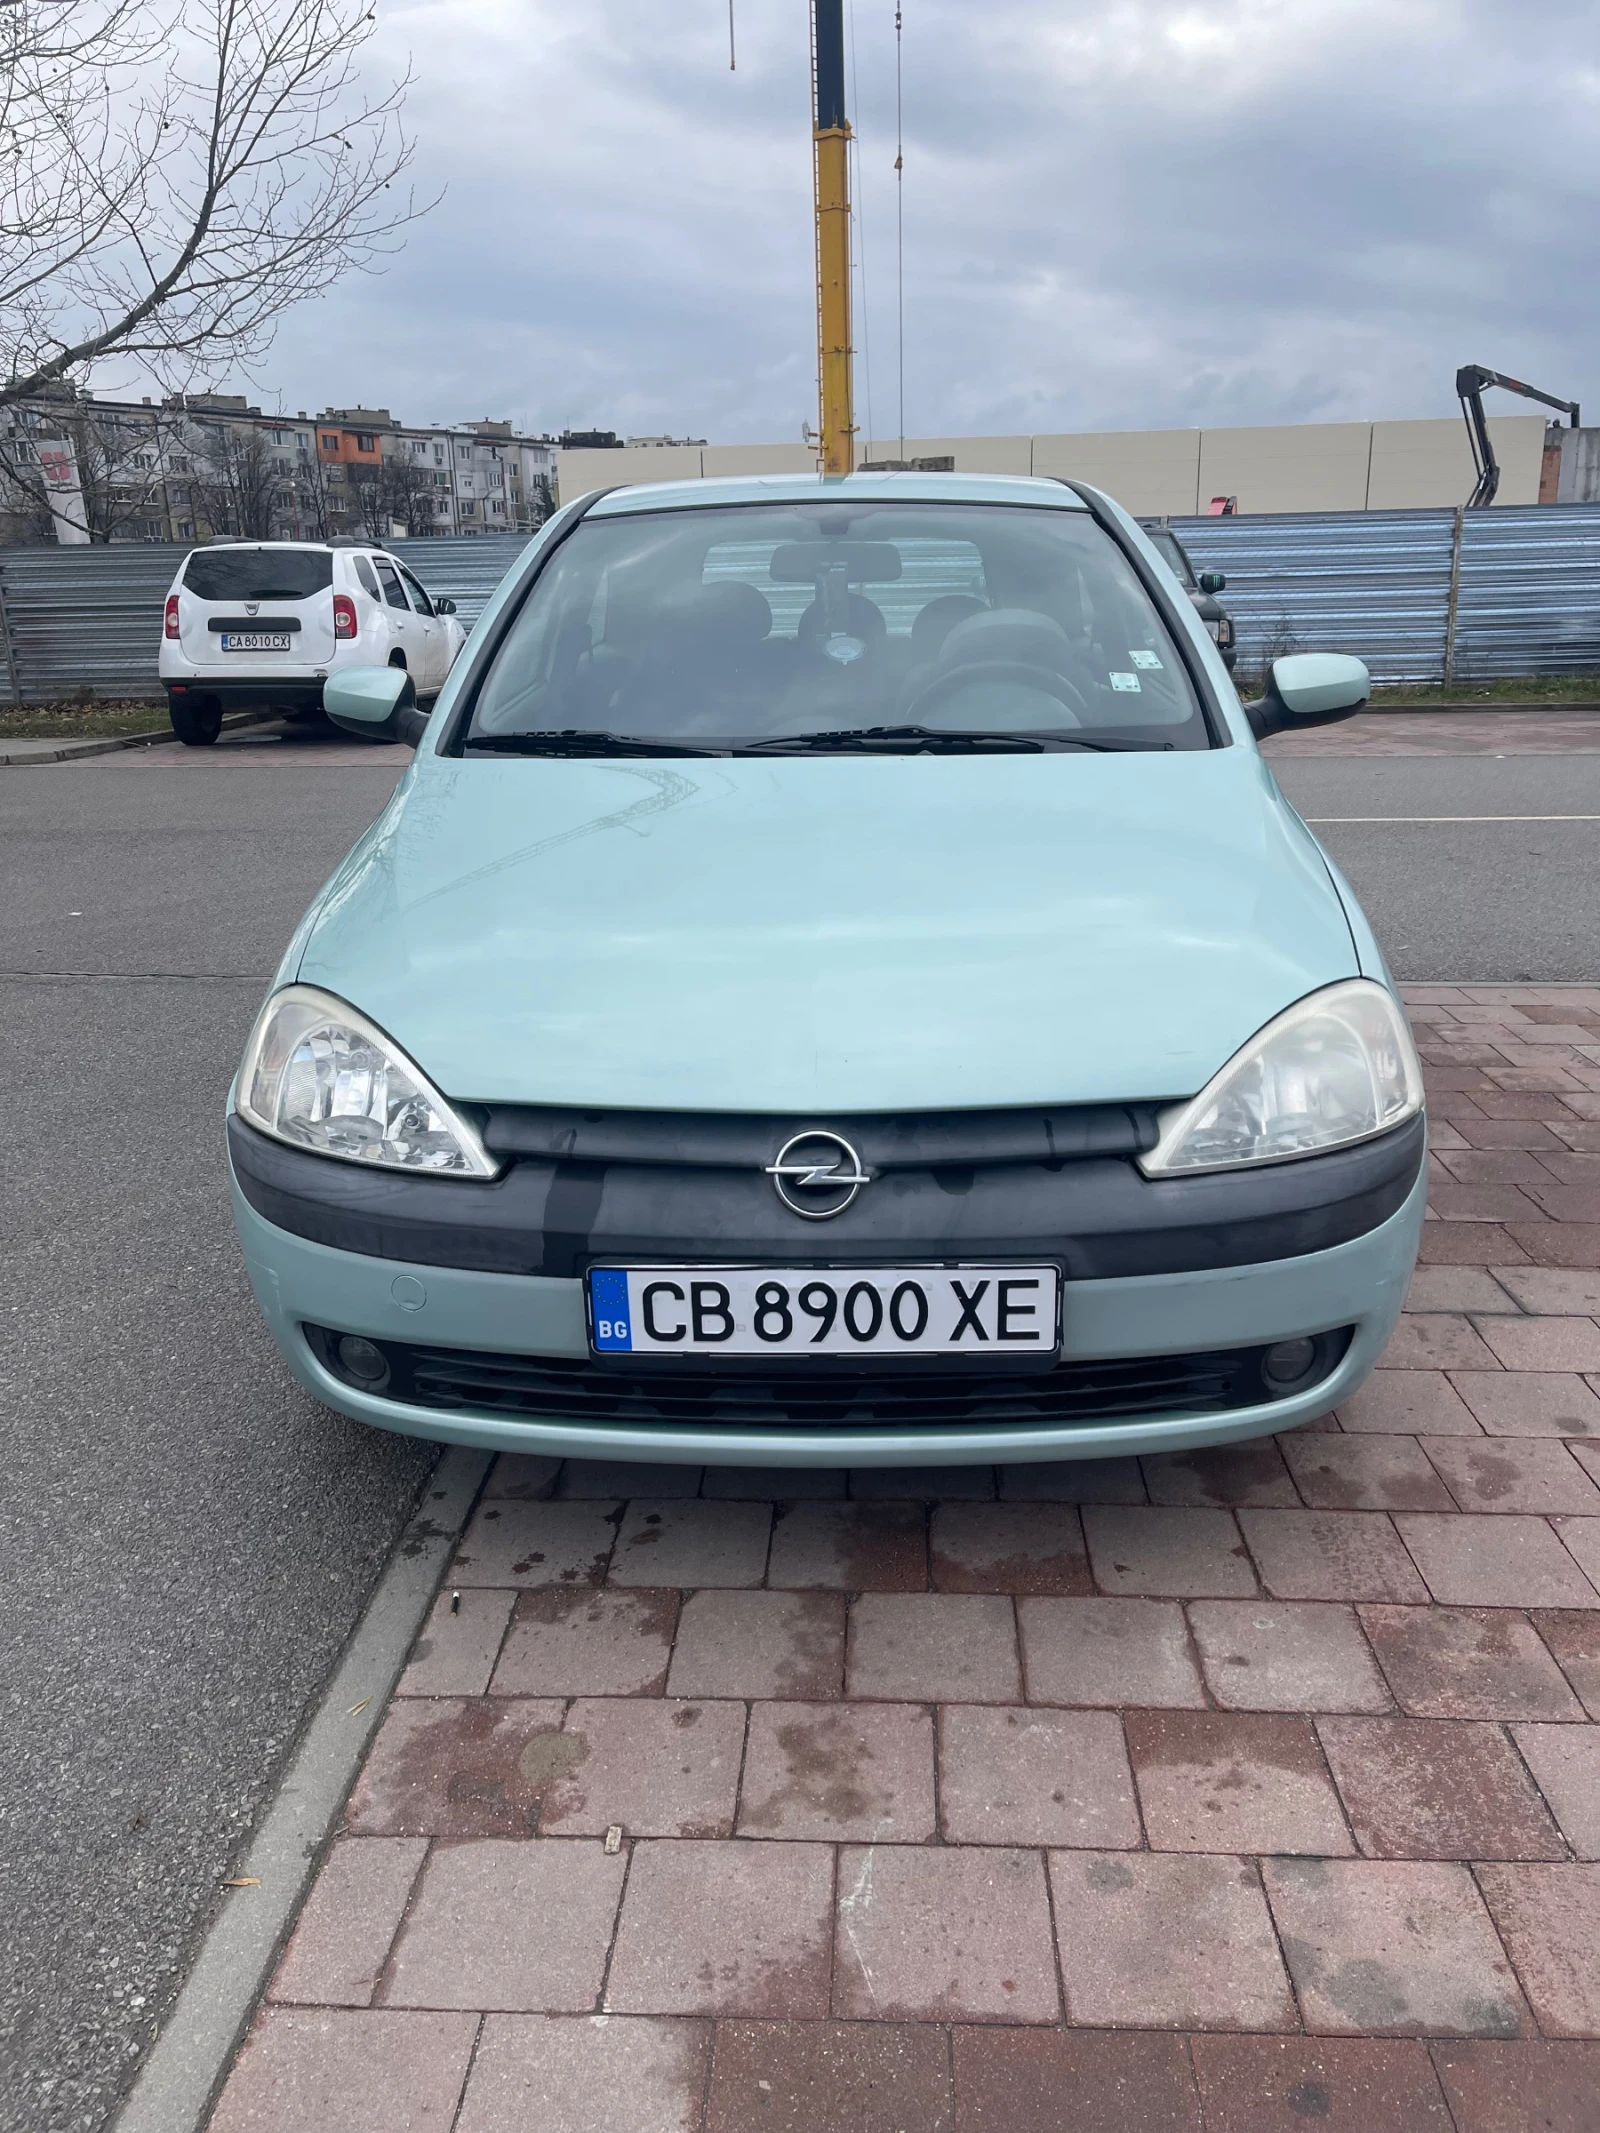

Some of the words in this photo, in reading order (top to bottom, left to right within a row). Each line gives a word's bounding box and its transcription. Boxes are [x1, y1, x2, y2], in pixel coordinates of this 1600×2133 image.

[229, 636, 243, 647] CA
[244, 636, 271, 647] 8010
[272, 636, 287, 647] CX
[642, 1281, 735, 1342] CB
[753, 1281, 929, 1343] 8900
[949, 1279, 1040, 1341] XE
[599, 1320, 628, 1340] BG
